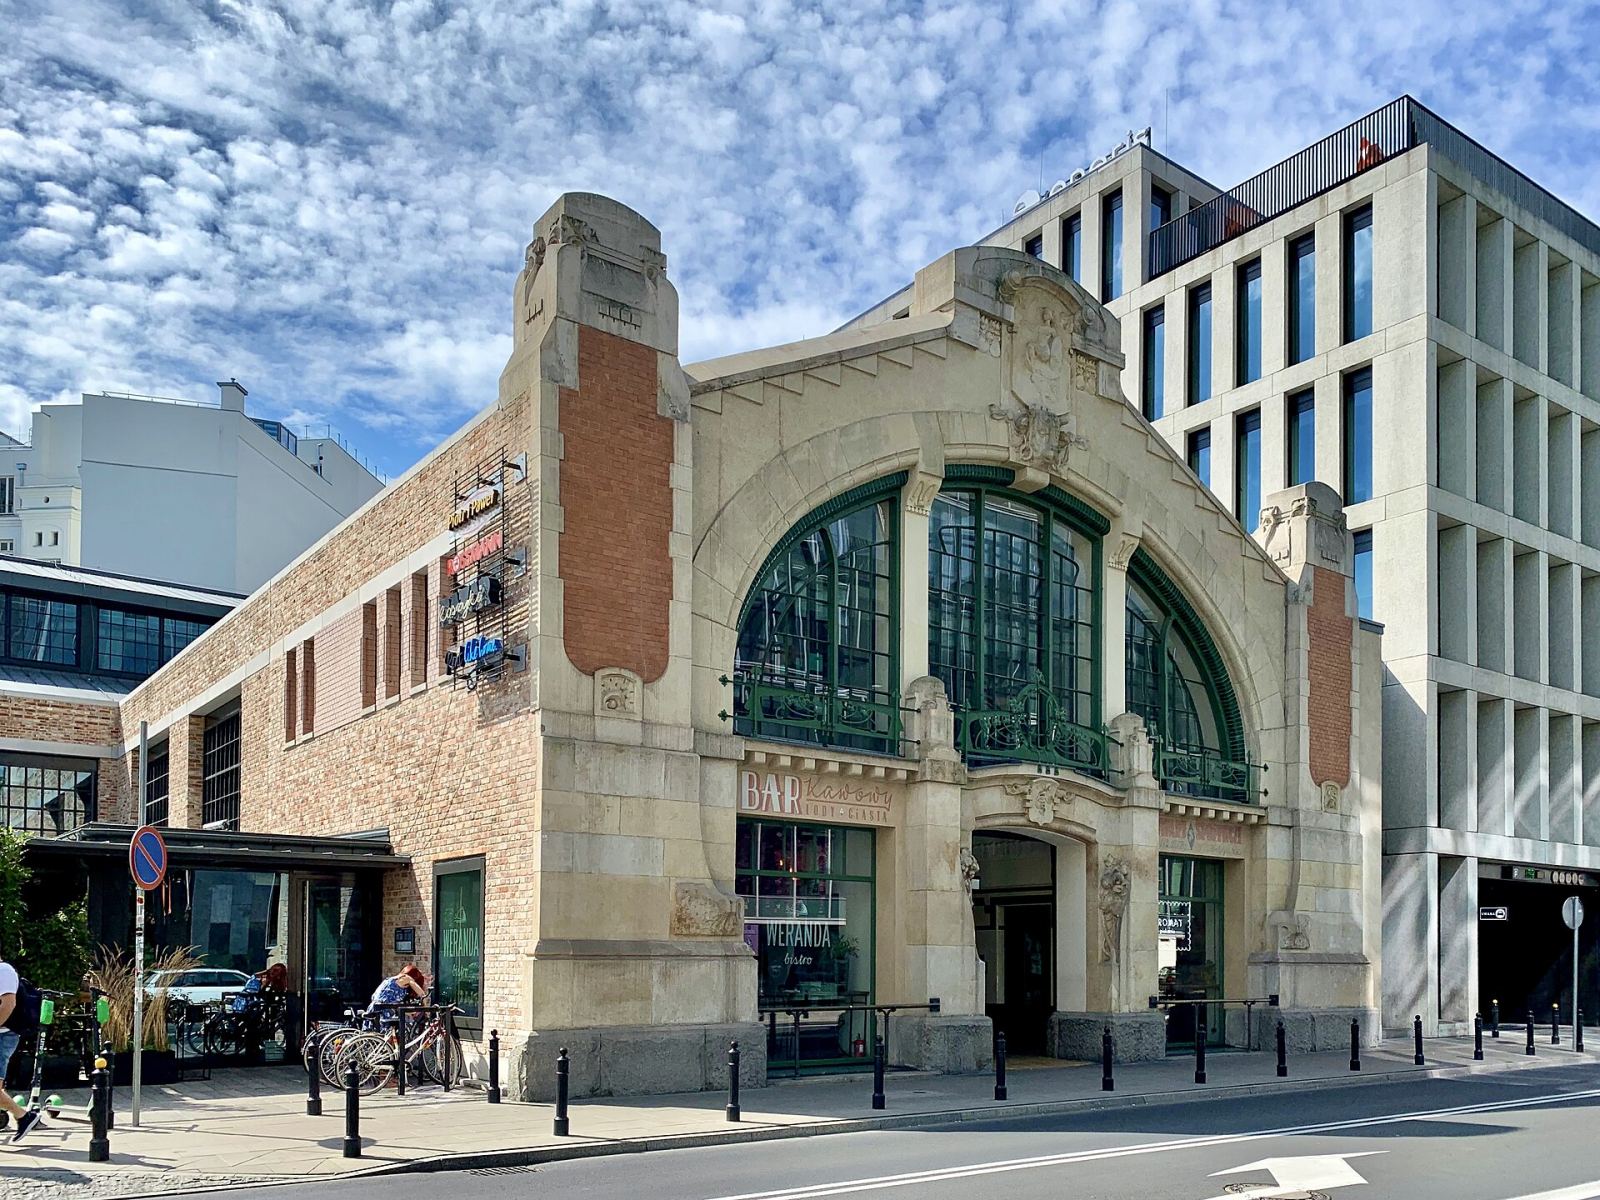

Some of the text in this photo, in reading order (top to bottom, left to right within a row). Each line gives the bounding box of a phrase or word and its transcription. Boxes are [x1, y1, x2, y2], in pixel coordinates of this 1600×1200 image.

[447, 530, 504, 576] ROSSMANN
[741, 770, 803, 815] BAR
[806, 803, 835, 818] LODY
[443, 927, 479, 957] WERANDA
[766, 920, 831, 948] WERANDA
[784, 952, 813, 966] bistro
